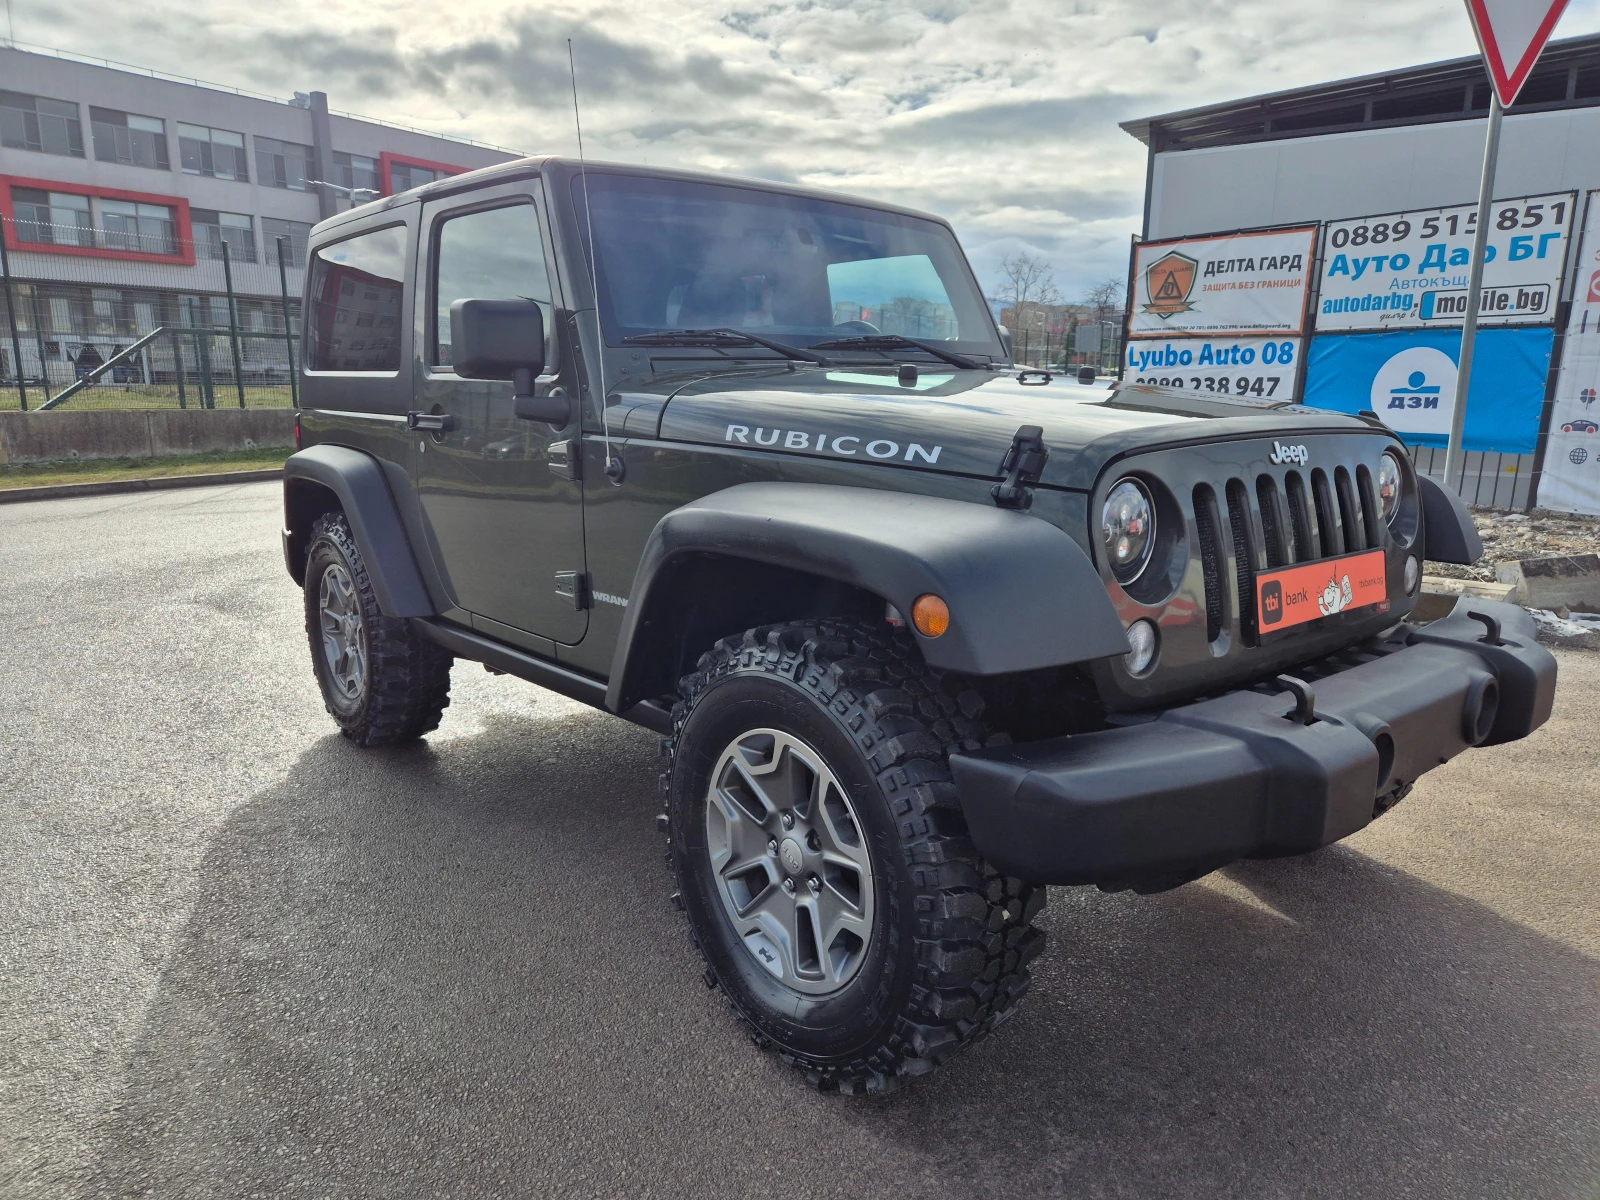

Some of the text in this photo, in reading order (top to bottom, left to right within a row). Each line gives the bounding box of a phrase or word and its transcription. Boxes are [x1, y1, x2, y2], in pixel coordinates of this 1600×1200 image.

[1331, 220, 1411, 249] 0889
[1496, 201, 1566, 231] 851
[1203, 254, 1303, 278] ДЕЛТА ГАРД
[1327, 253, 1411, 282] Ауто
[1507, 232, 1561, 262] БГ
[1202, 279, 1301, 292] ЗАЩИТА БЕЗ ГРАНИЦИ
[1388, 277, 1470, 290] Автокъщ
[1436, 288, 1544, 314] moile.bg
[1128, 341, 1294, 372] Lyubo Auto 08
[1235, 376, 1281, 397] 947
[1387, 396, 1439, 410] ДЗИ
[725, 424, 943, 464] RUBICON
[1269, 440, 1309, 467] Jeep
[1265, 586, 1308, 611] tbi bank
